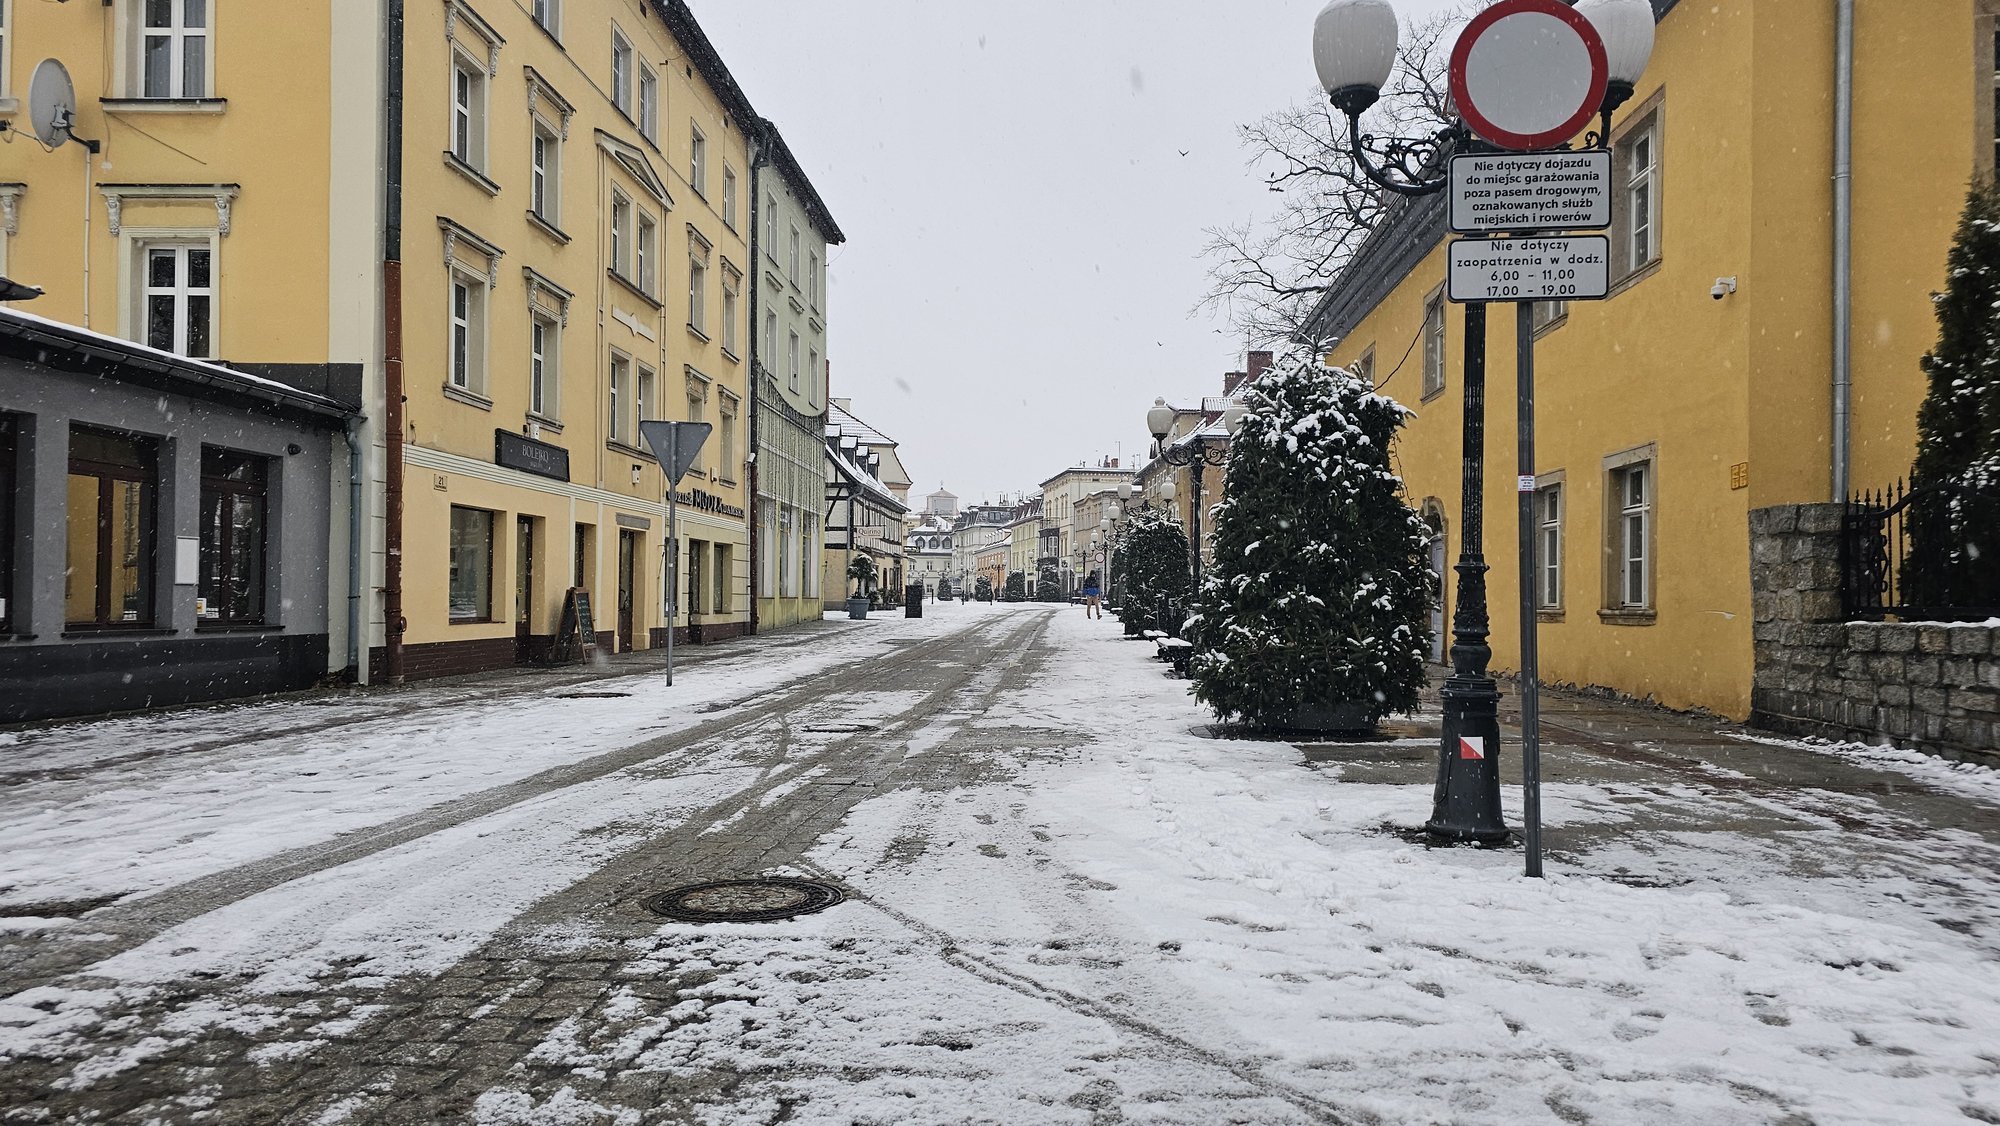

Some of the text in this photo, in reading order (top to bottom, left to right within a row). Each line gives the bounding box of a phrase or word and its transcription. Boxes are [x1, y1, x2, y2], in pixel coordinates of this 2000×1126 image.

[1474, 158, 1591, 172] Nie dotyczy dojazdu
[1466, 171, 1599, 185] do miejsc garażowania
[1464, 187, 1601, 200] poza pasem drogowym,
[1472, 198, 1593, 211] oznakowanych służb
[1474, 211, 1591, 225] miejskich i rowerów
[1491, 240, 1569, 252] Nie dotyczy
[1457, 255, 1542, 269] zaopatrzenia
[1568, 254, 1603, 264] dodz.
[1491, 271, 1519, 282] 6,00
[1542, 269, 1574, 281] 11,00
[1486, 286, 1519, 297] 17,00
[1542, 285, 1576, 295] 19,00
[438, 476, 444, 485] 21
